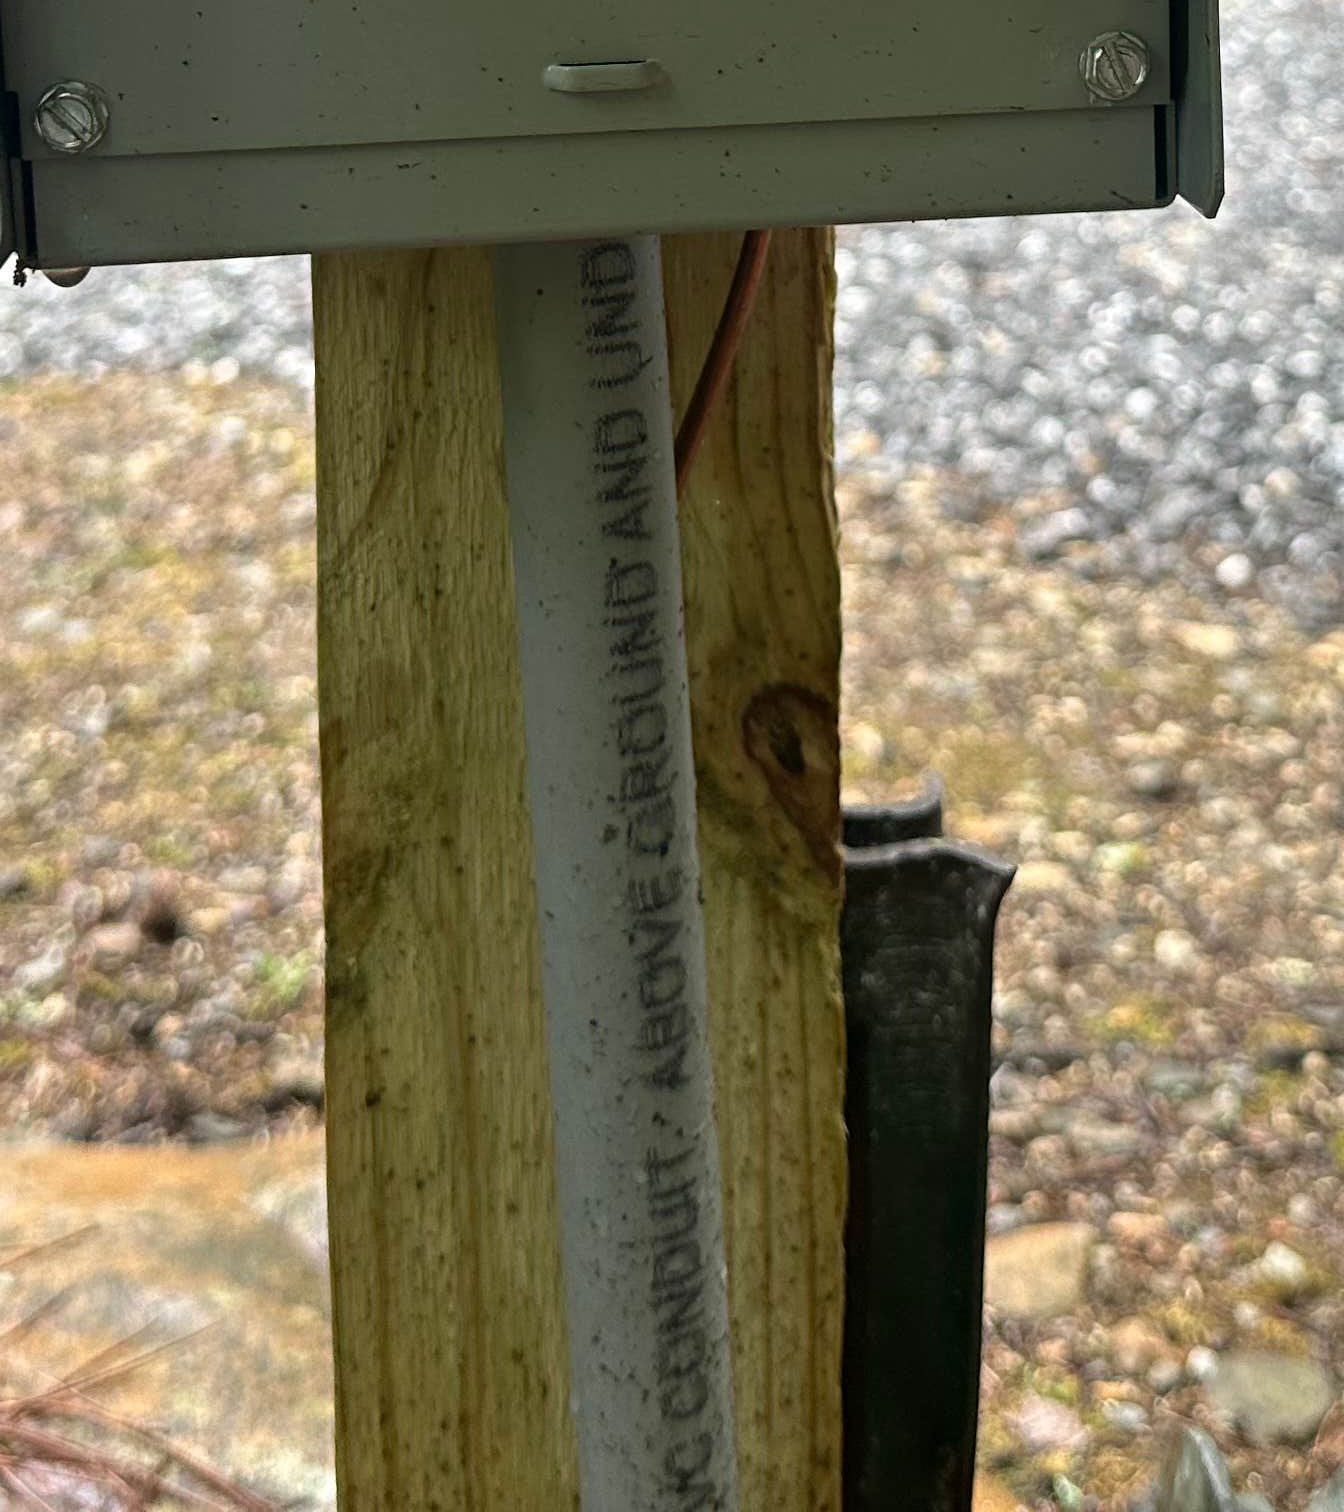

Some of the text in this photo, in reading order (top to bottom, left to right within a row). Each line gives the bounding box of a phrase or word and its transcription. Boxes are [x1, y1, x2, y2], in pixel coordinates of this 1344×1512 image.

[592, 408, 654, 540] AND
[604, 559, 678, 857] GROUND
[628, 869, 692, 1092] ABOVE
